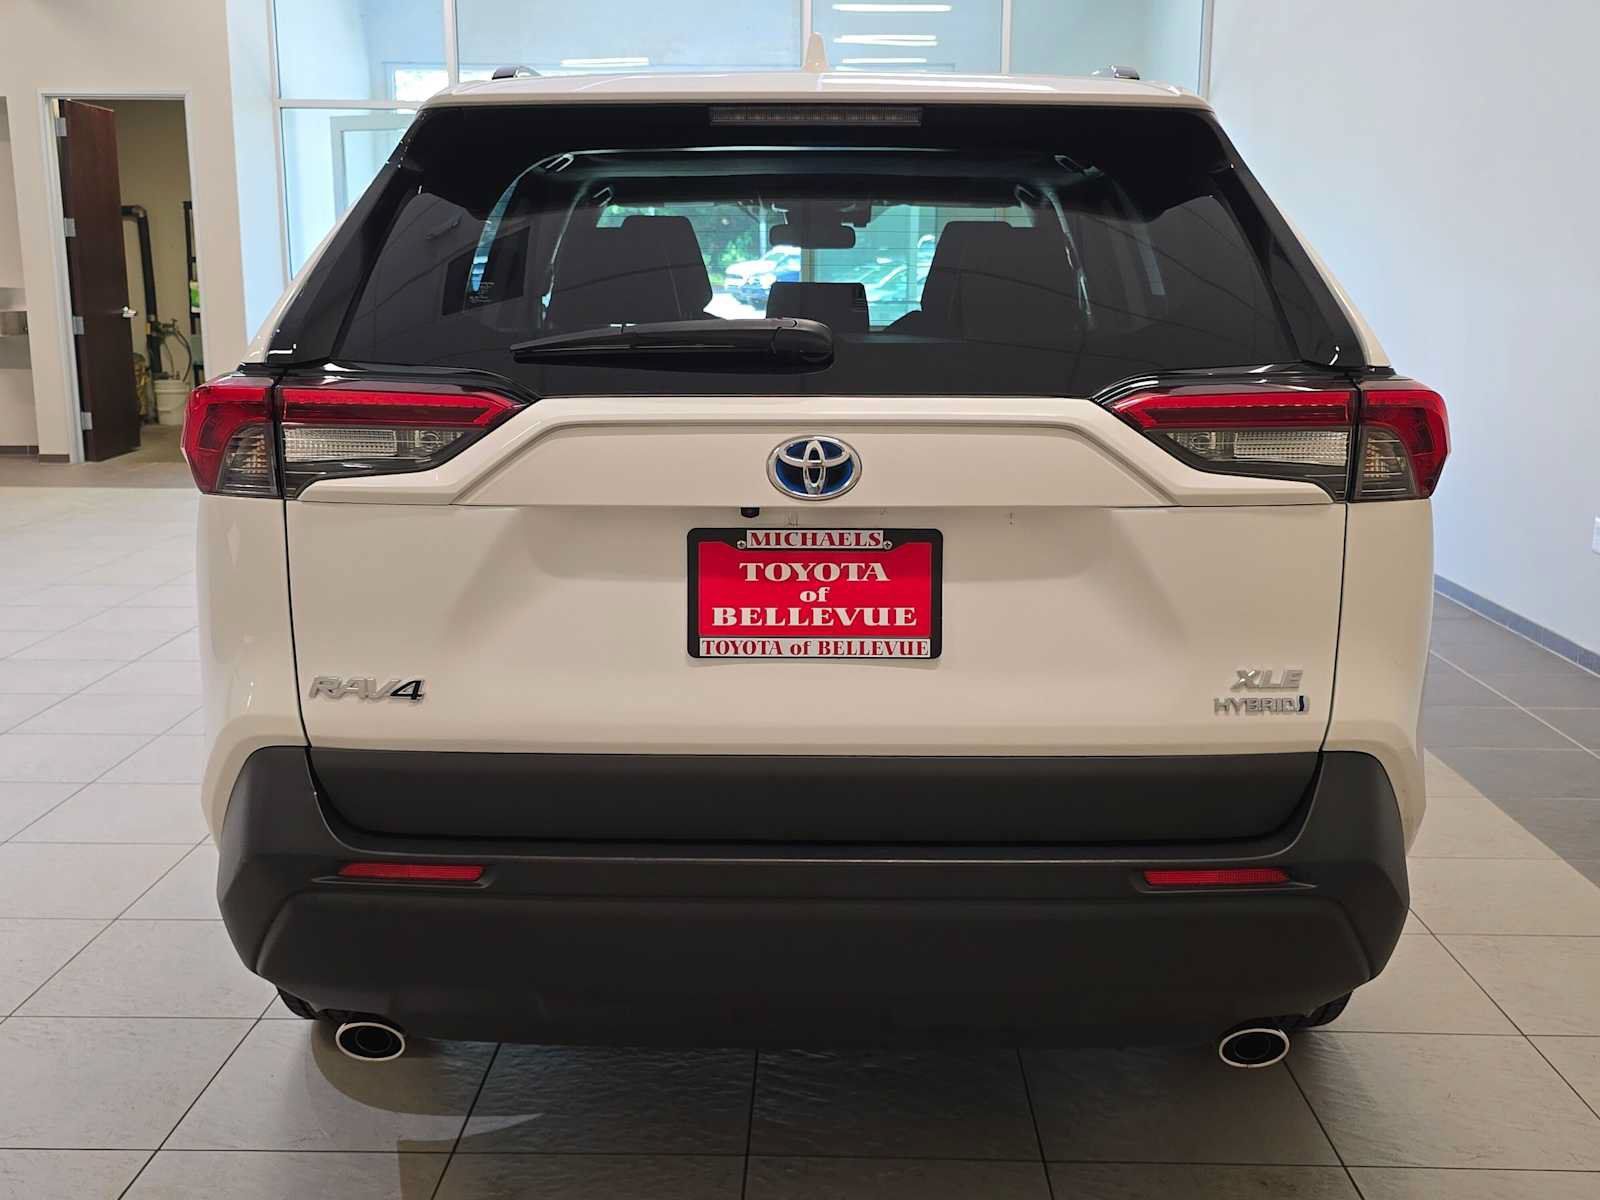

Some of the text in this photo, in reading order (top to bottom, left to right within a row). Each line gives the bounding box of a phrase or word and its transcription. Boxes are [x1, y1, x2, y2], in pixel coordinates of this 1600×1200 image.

[750, 531, 881, 547] MICHAELS
[739, 562, 891, 582] TOYOTA
[799, 586, 831, 603] of
[711, 607, 917, 627] BELLEVUE
[701, 640, 929, 657] TOYOTA of BELLEVUE
[309, 676, 425, 701] RAV4
[1231, 669, 1303, 690] XLE
[1214, 697, 1298, 714] HYBRID
